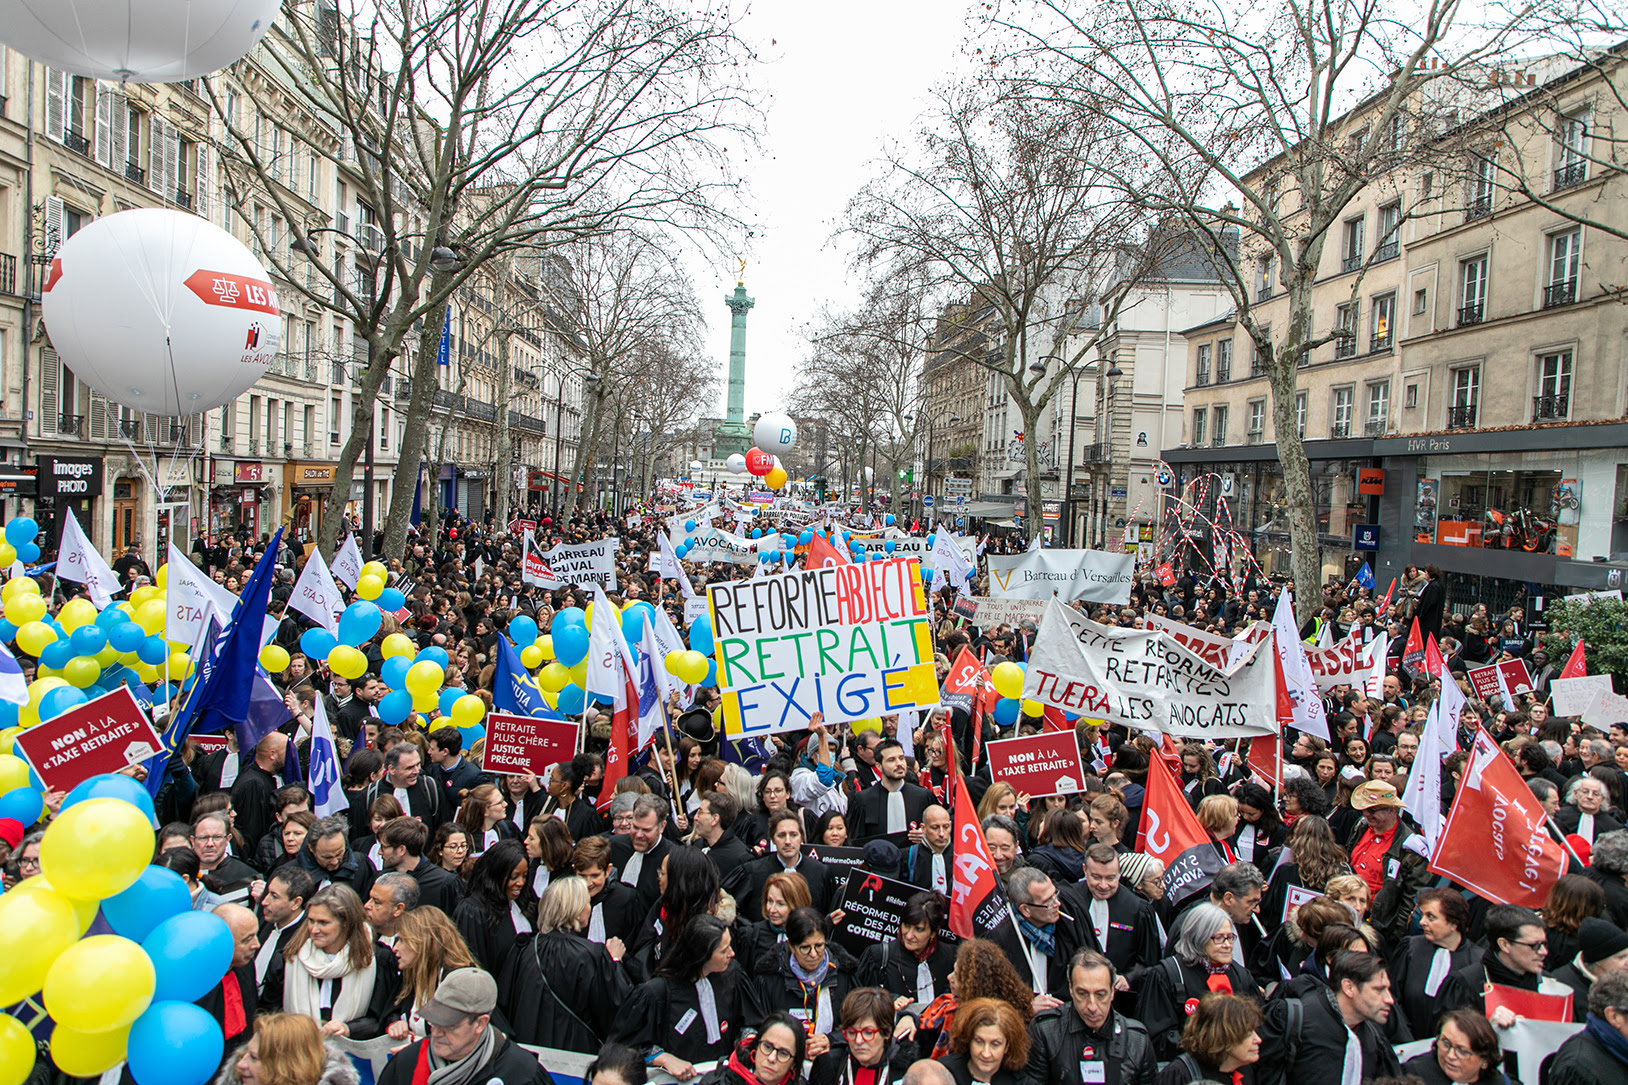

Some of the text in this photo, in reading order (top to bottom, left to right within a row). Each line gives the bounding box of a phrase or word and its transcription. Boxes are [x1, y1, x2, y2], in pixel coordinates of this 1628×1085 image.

[244, 284, 267, 306] LES
[1408, 439, 1449, 451] HVR Paris
[53, 459, 93, 478] images
[57, 480, 88, 493] PHOTO
[1361, 476, 1382, 485] KTM
[693, 537, 748, 553] AVOCATS
[860, 543, 920, 552] AREAU
[551, 547, 605, 564] BARREAU
[570, 561, 594, 571] VAL
[571, 572, 611, 583] MARNE
[1023, 569, 1068, 582] Barreau
[1082, 568, 1131, 584] Versailles
[711, 557, 926, 637] RÉFORME ABJECTE
[1070, 622, 1127, 652] CETTE
[721, 618, 927, 687] RETRAIT
[1474, 669, 1497, 678] RETRAIT
[737, 653, 915, 732] EXIGÉ
[1036, 670, 1248, 728] TUERA LES AVOCATS
[1564, 690, 1593, 700] AVOCA
[51, 715, 117, 751] NON À LA
[494, 721, 537, 735] RETRAITE
[50, 744, 82, 767] TAXE
[80, 726, 132, 753] RETRAITE
[493, 732, 517, 744] PLUS
[519, 734, 549, 748] CHÈRE
[491, 743, 525, 755] JUSTICE
[1008, 748, 1059, 764] NON À LA
[490, 753, 531, 767] PRÉCAIRE
[1003, 764, 1027, 777] TAXE
[1027, 760, 1068, 775] RETRAITE
[844, 900, 889, 922] RÉFORME
[847, 924, 882, 941] COTISE
[864, 918, 883, 931] DES
[1184, 1004, 1196, 1013] SA
